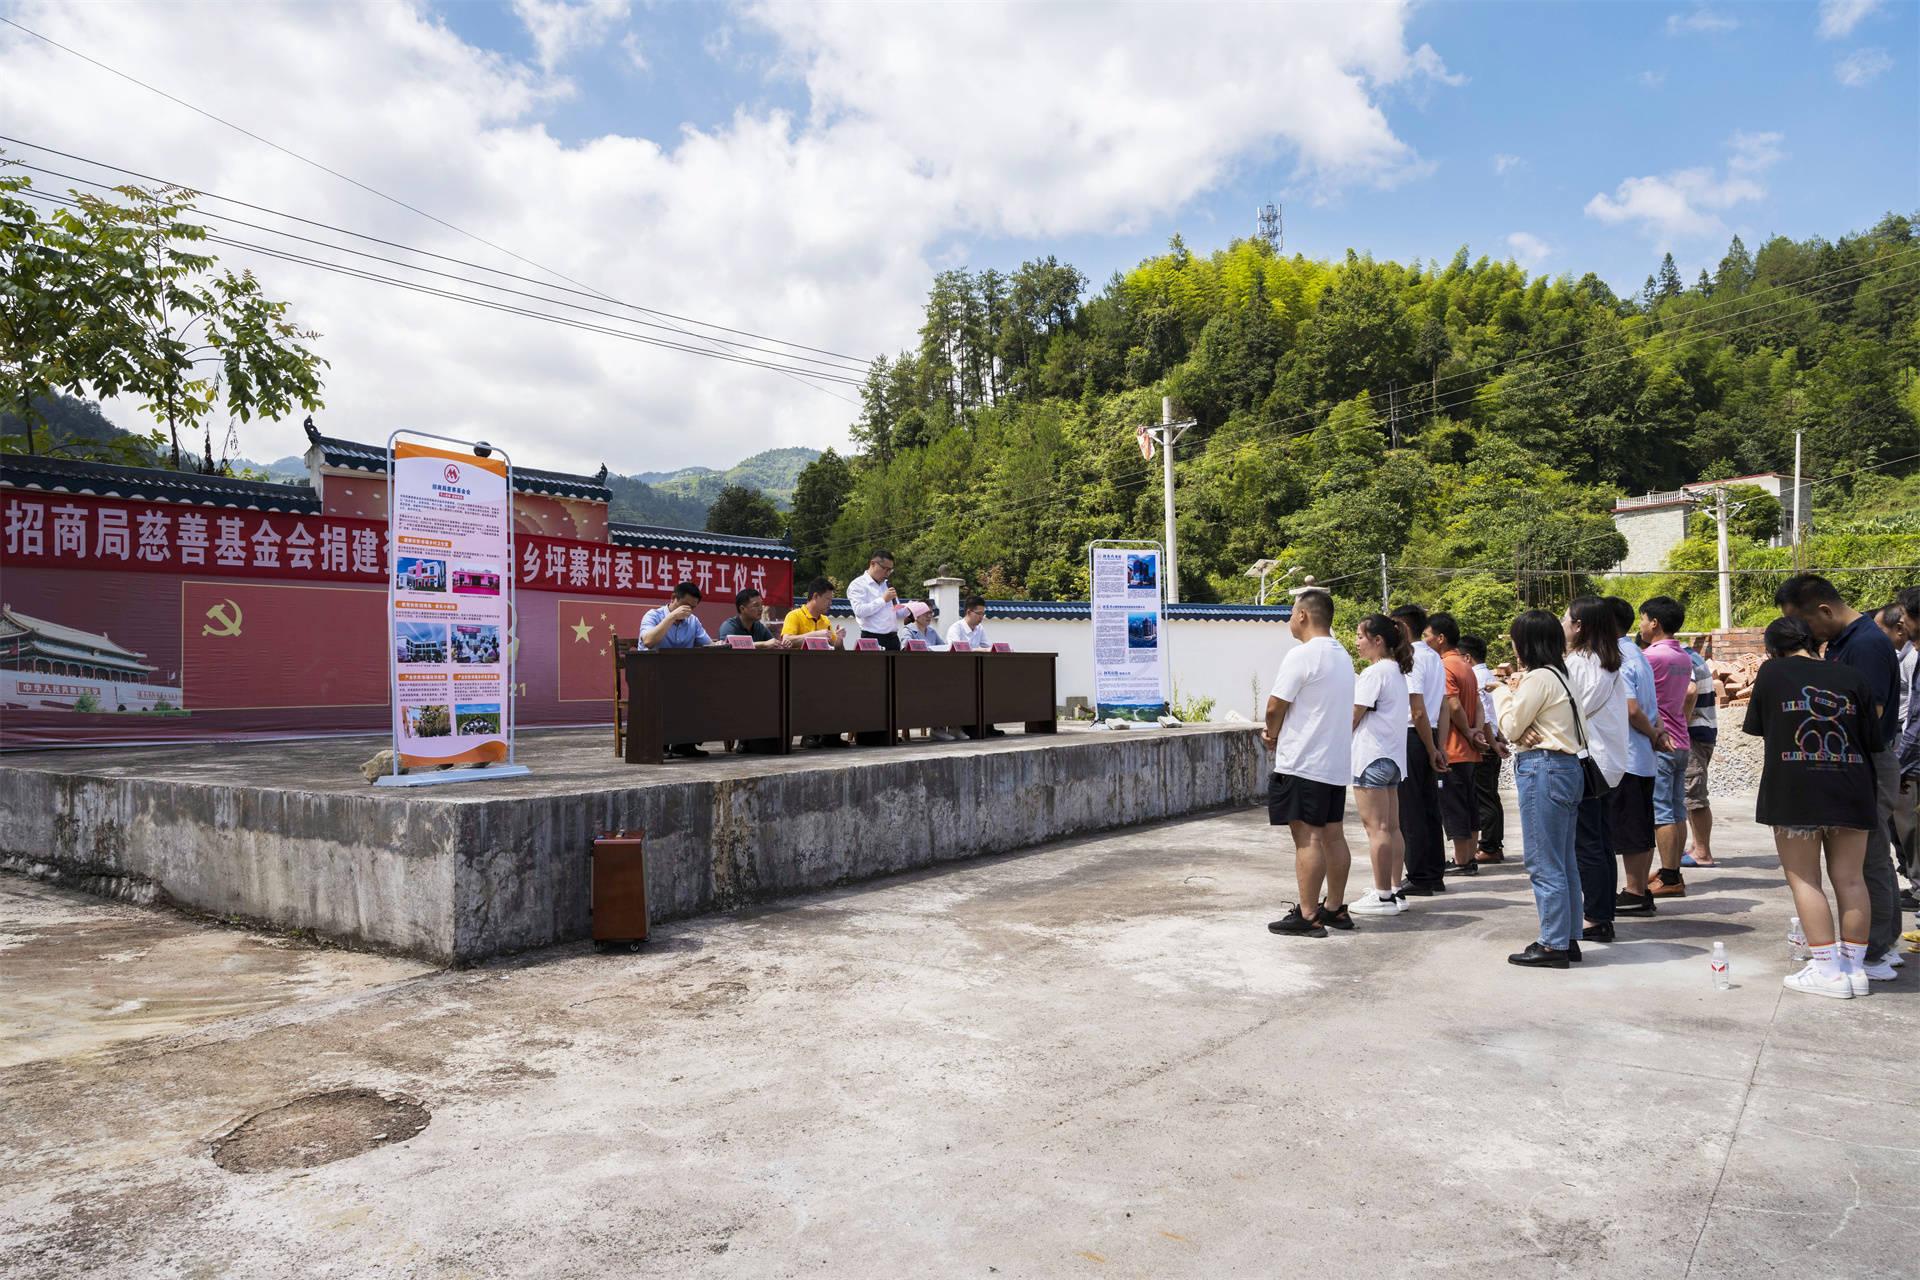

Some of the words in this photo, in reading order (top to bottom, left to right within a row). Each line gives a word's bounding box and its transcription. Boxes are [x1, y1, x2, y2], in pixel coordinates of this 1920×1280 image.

[5, 499, 389, 575] 招商局慈善基金会捐建
[508, 541, 767, 598] 乡坪寨村委卫生室开工仪式
